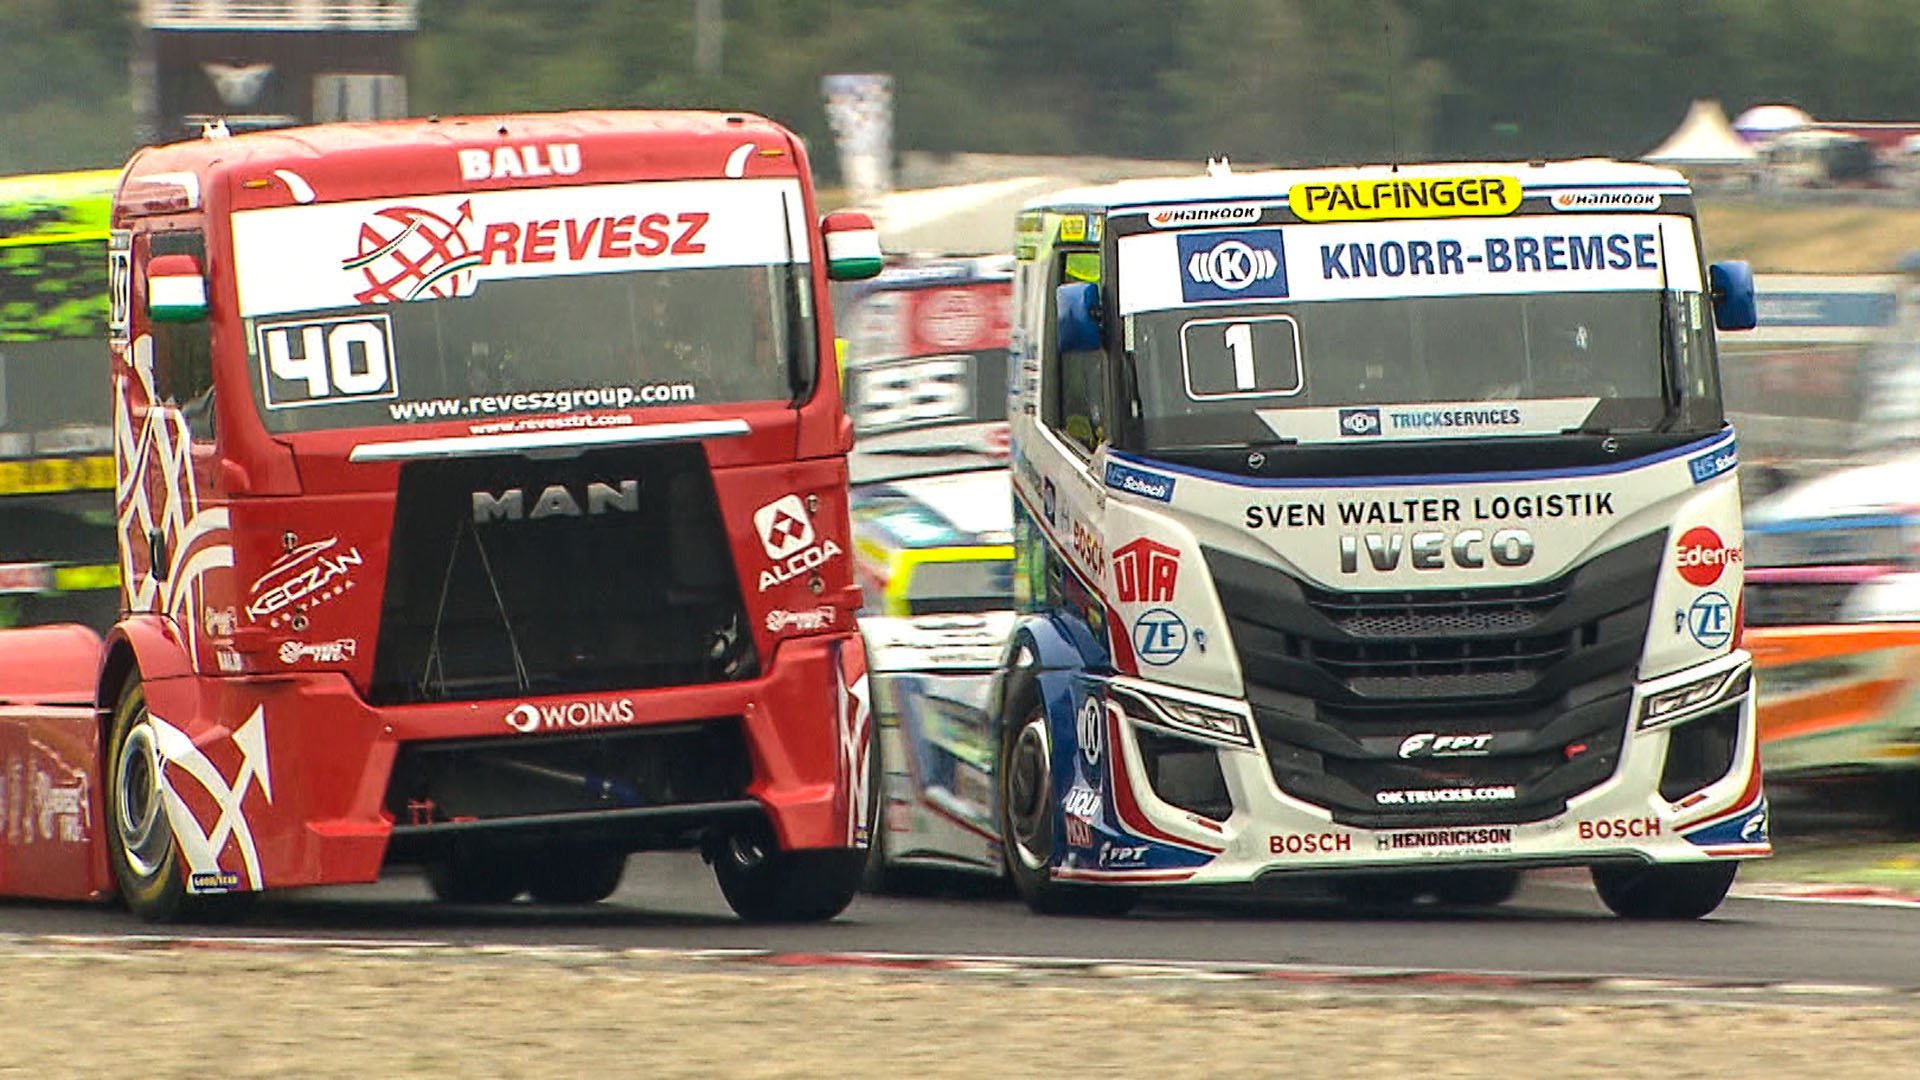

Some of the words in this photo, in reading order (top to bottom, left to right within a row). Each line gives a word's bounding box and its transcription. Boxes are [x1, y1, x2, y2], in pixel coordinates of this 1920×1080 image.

[457, 143, 581, 181] BALU
[1304, 178, 1507, 212] PALFINGER
[1320, 233, 1659, 280] KNORR-BREMSE
[267, 322, 388, 398] 40
[1223, 322, 1256, 390] 1
[389, 383, 696, 420] www.reveszgroup.com
[1390, 408, 1521, 429] TRUCKSERVICES
[472, 479, 639, 524] MAN
[1245, 503, 1325, 529] SVEN
[1337, 499, 1461, 525] WALTER
[1474, 492, 1615, 520] LOGISTIK
[758, 539, 843, 593] ALCOA
[1111, 537, 1181, 602] UTA
[1339, 528, 1535, 574] IVECO
[1136, 619, 1182, 655] ZF
[1691, 603, 1731, 638] ZF
[540, 699, 635, 728] WOIMS
[1432, 735, 1493, 749] FPT
[1269, 833, 1351, 855] BOSCH
[1391, 828, 1512, 848] HENDRICKSON
[1578, 817, 1661, 839] BOSCH
